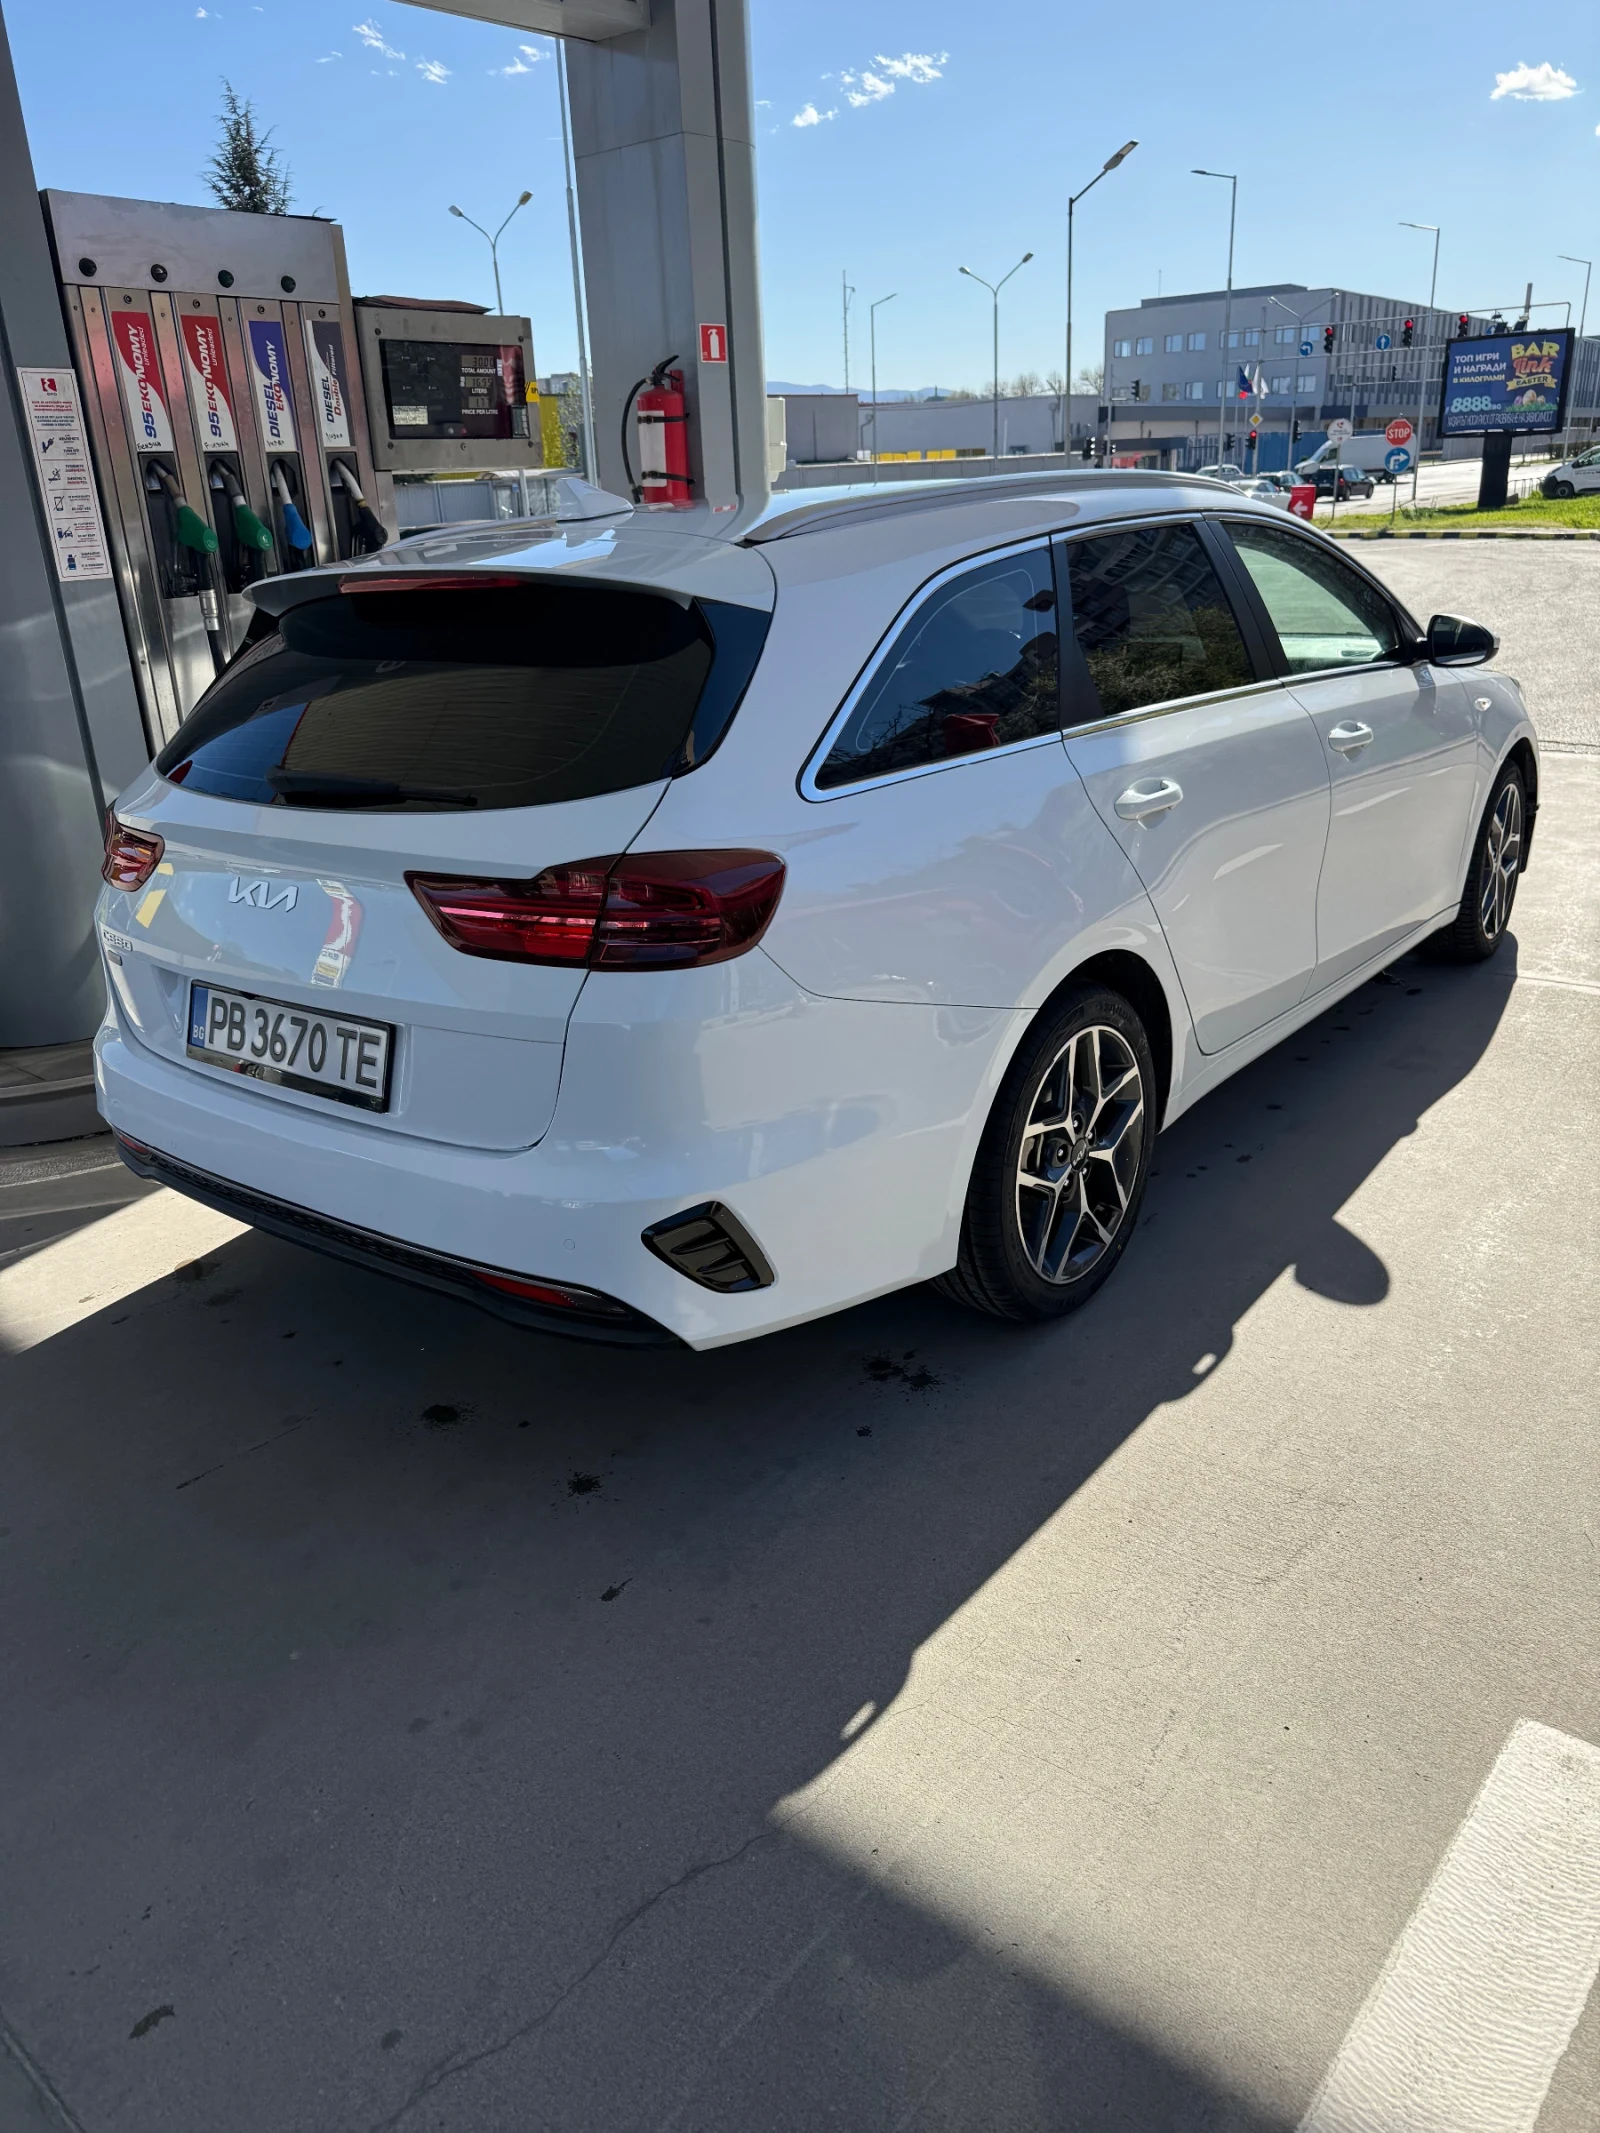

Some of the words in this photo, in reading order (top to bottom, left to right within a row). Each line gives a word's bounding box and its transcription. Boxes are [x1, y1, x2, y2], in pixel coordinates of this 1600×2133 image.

[137, 326, 150, 366] unleaded
[206, 327, 218, 367] unleaded
[328, 344, 338, 376] Filtered
[1455, 355, 1474, 364] ТОП
[1475, 352, 1500, 362] ИГРИ
[1511, 341, 1560, 360] BAR
[265, 340, 284, 412] EKONOMY
[1453, 366, 1461, 374] И
[1462, 362, 1507, 374] НАГРАДИ
[1459, 374, 1505, 383] КИЛОГРАМИ
[1516, 375, 1548, 386] EASTER
[264, 381, 281, 439] DIESEL
[321, 376, 335, 423] DIESEL
[331, 379, 342, 416] Double
[1388, 428, 1410, 440] STOP
[228, 877, 298, 913] KIA
[192, 1024, 205, 1041] BG
[208, 996, 247, 1052] PB
[250, 1008, 327, 1073] 3670
[336, 1026, 382, 1089] TE
